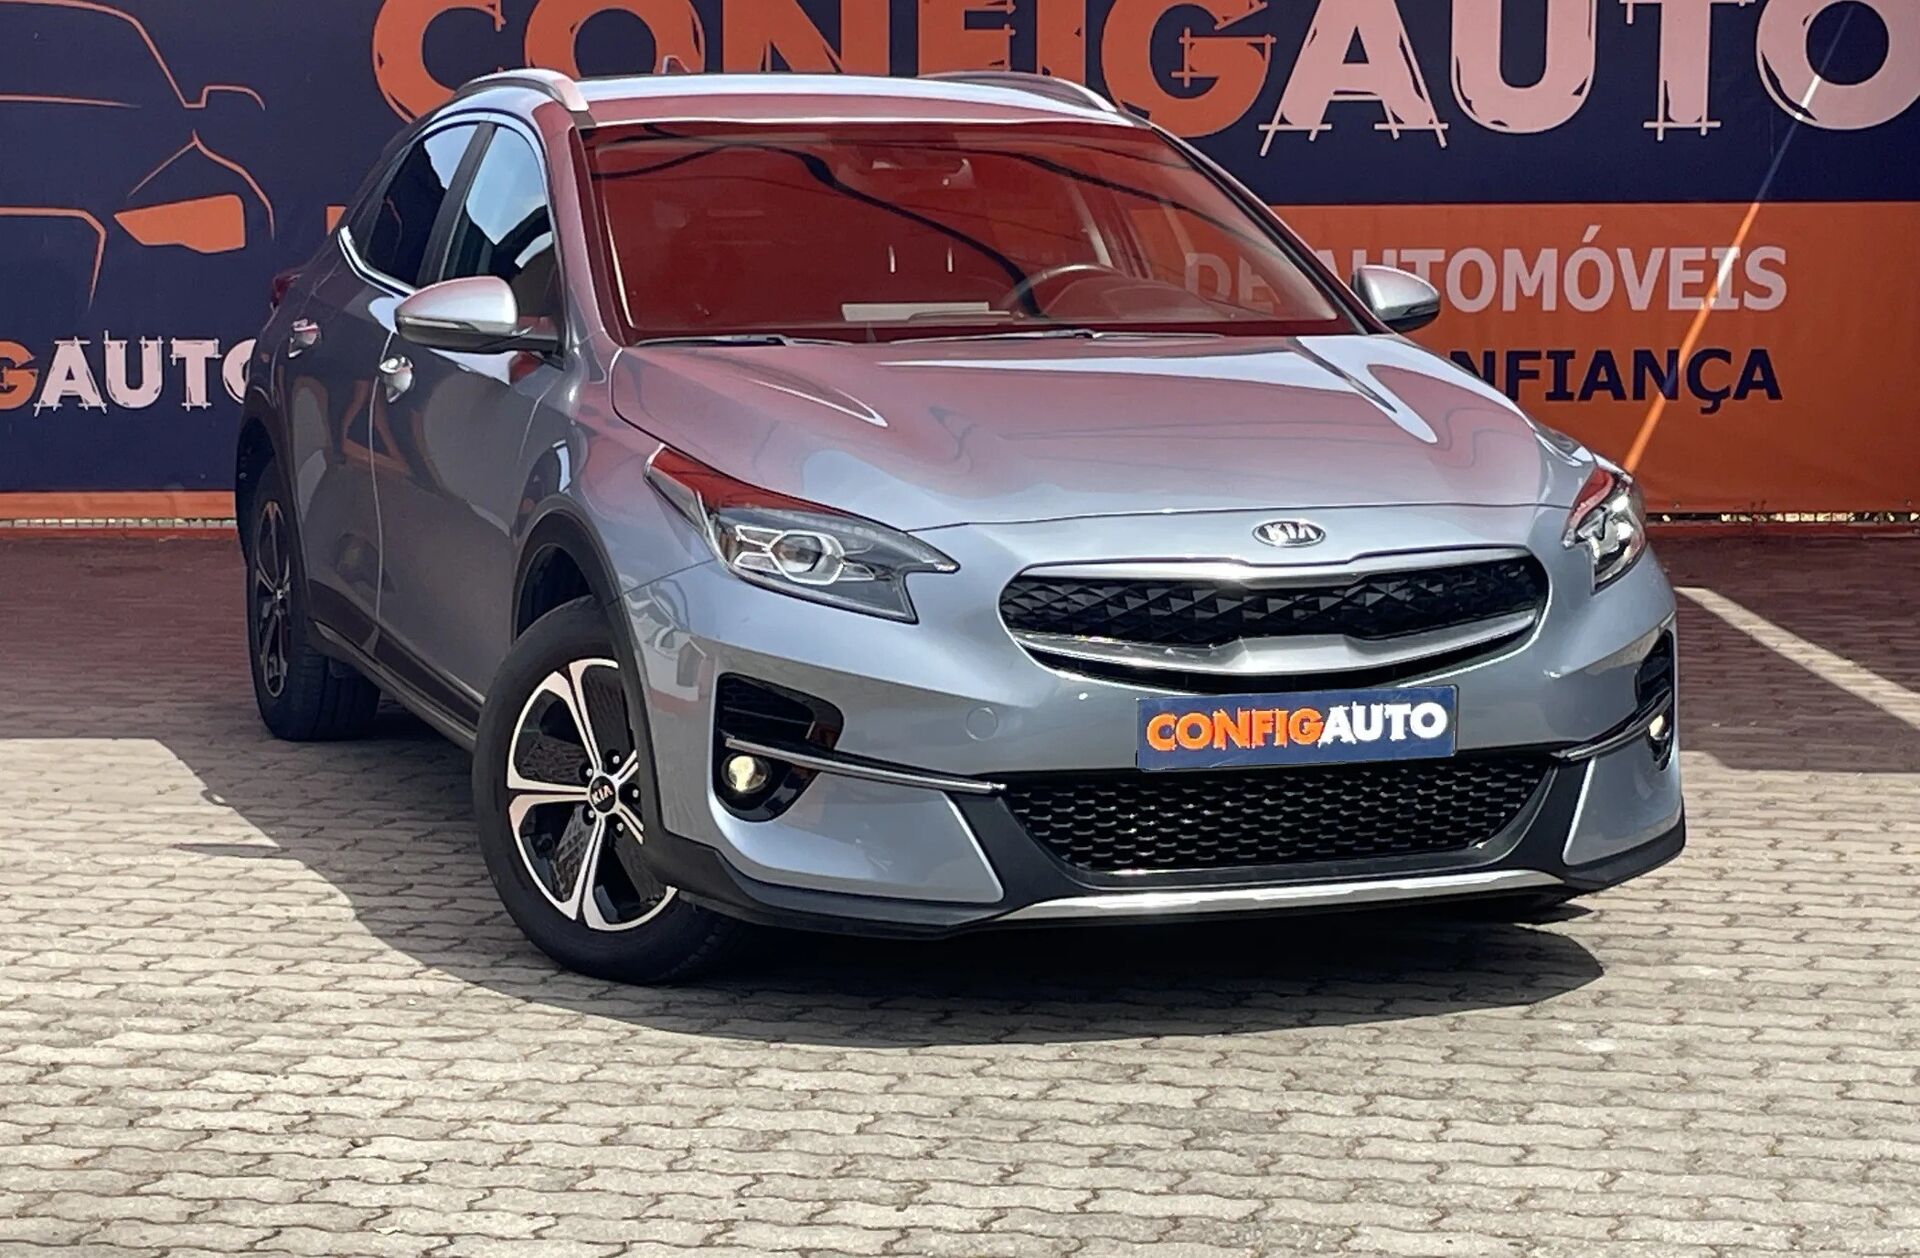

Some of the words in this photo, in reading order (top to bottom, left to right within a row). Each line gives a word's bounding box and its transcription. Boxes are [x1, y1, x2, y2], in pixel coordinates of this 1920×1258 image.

[1312, 225, 1787, 313] TOMÓVEIS
[1260, 521, 1320, 542] KIA
[1146, 701, 1449, 751] CONFIGAUTO
[590, 784, 614, 805] KIA
